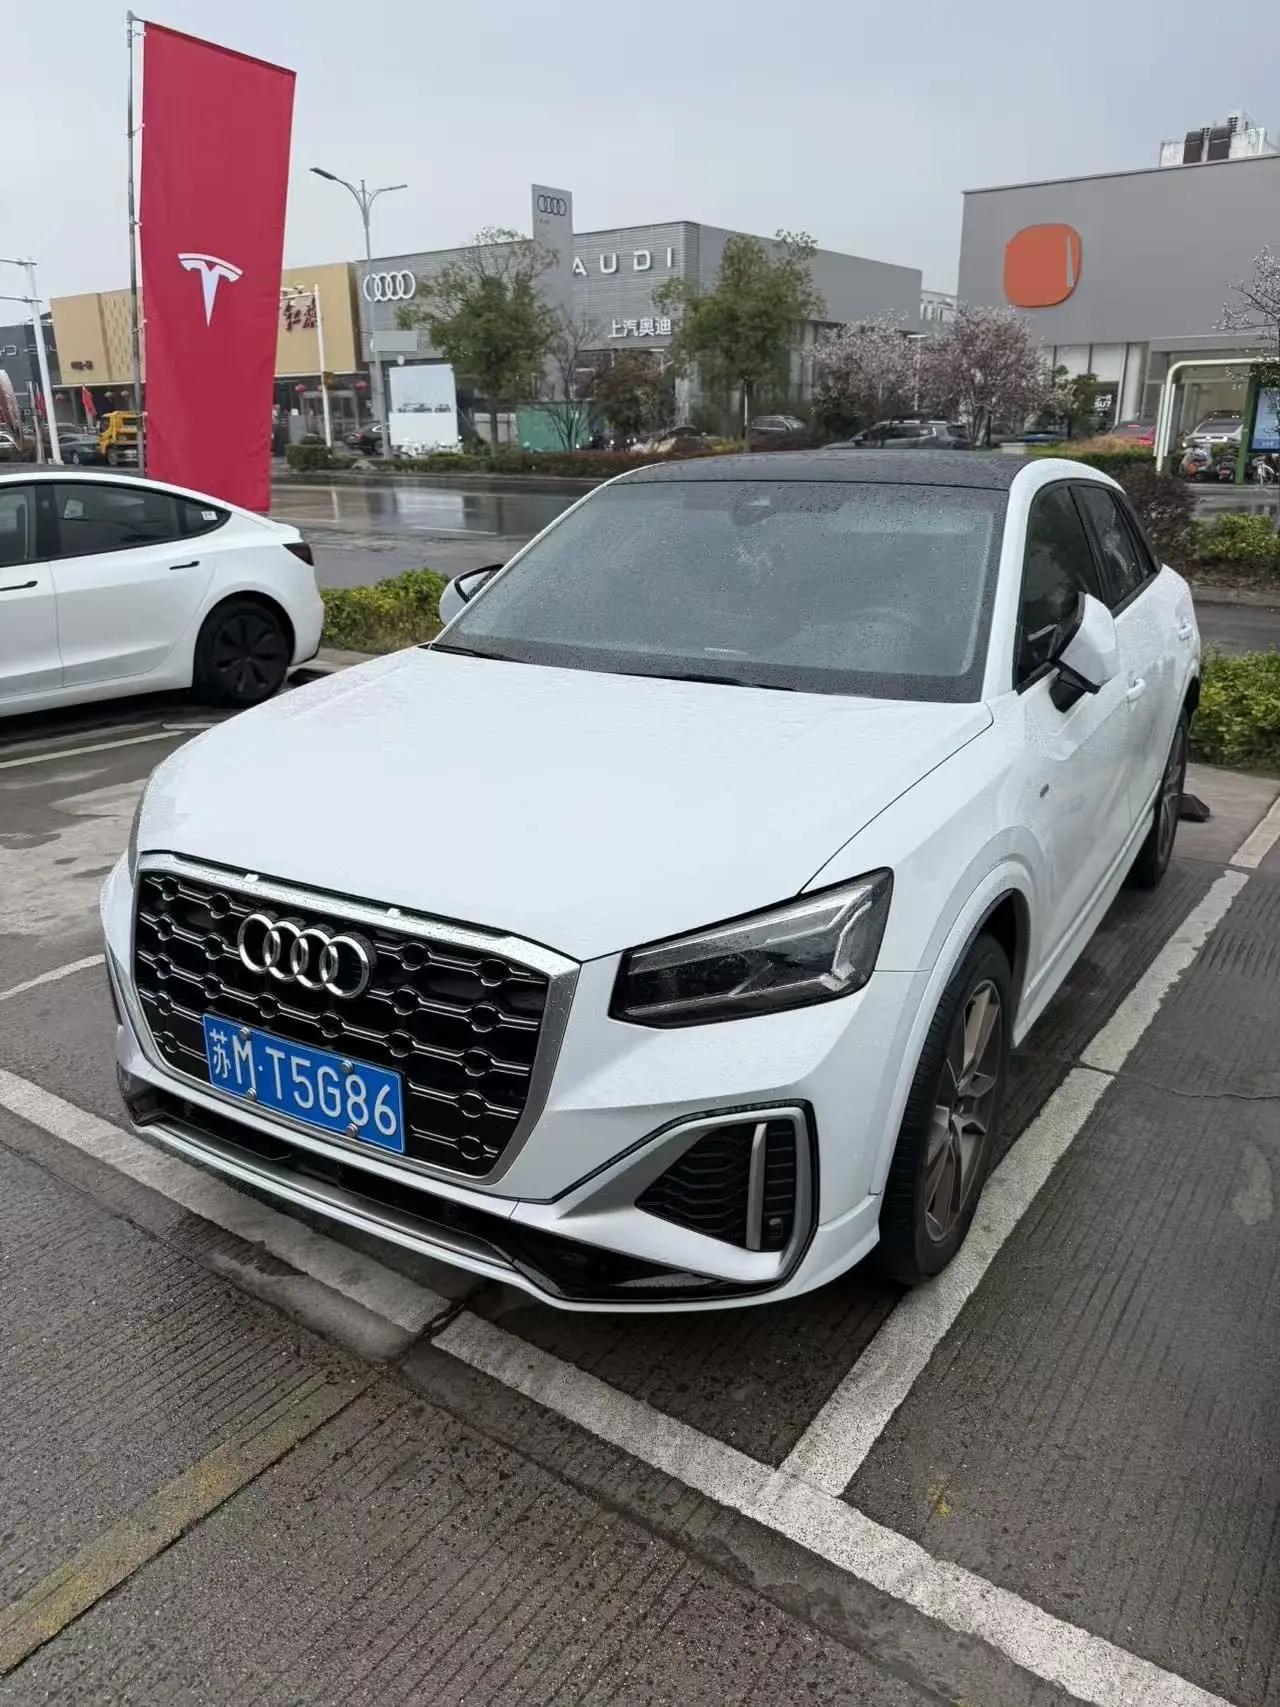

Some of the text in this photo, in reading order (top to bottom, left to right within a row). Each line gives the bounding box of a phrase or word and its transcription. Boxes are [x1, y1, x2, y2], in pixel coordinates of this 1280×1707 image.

[572, 247, 672, 277] AUDI
[608, 316, 672, 338] 上汽奥迪
